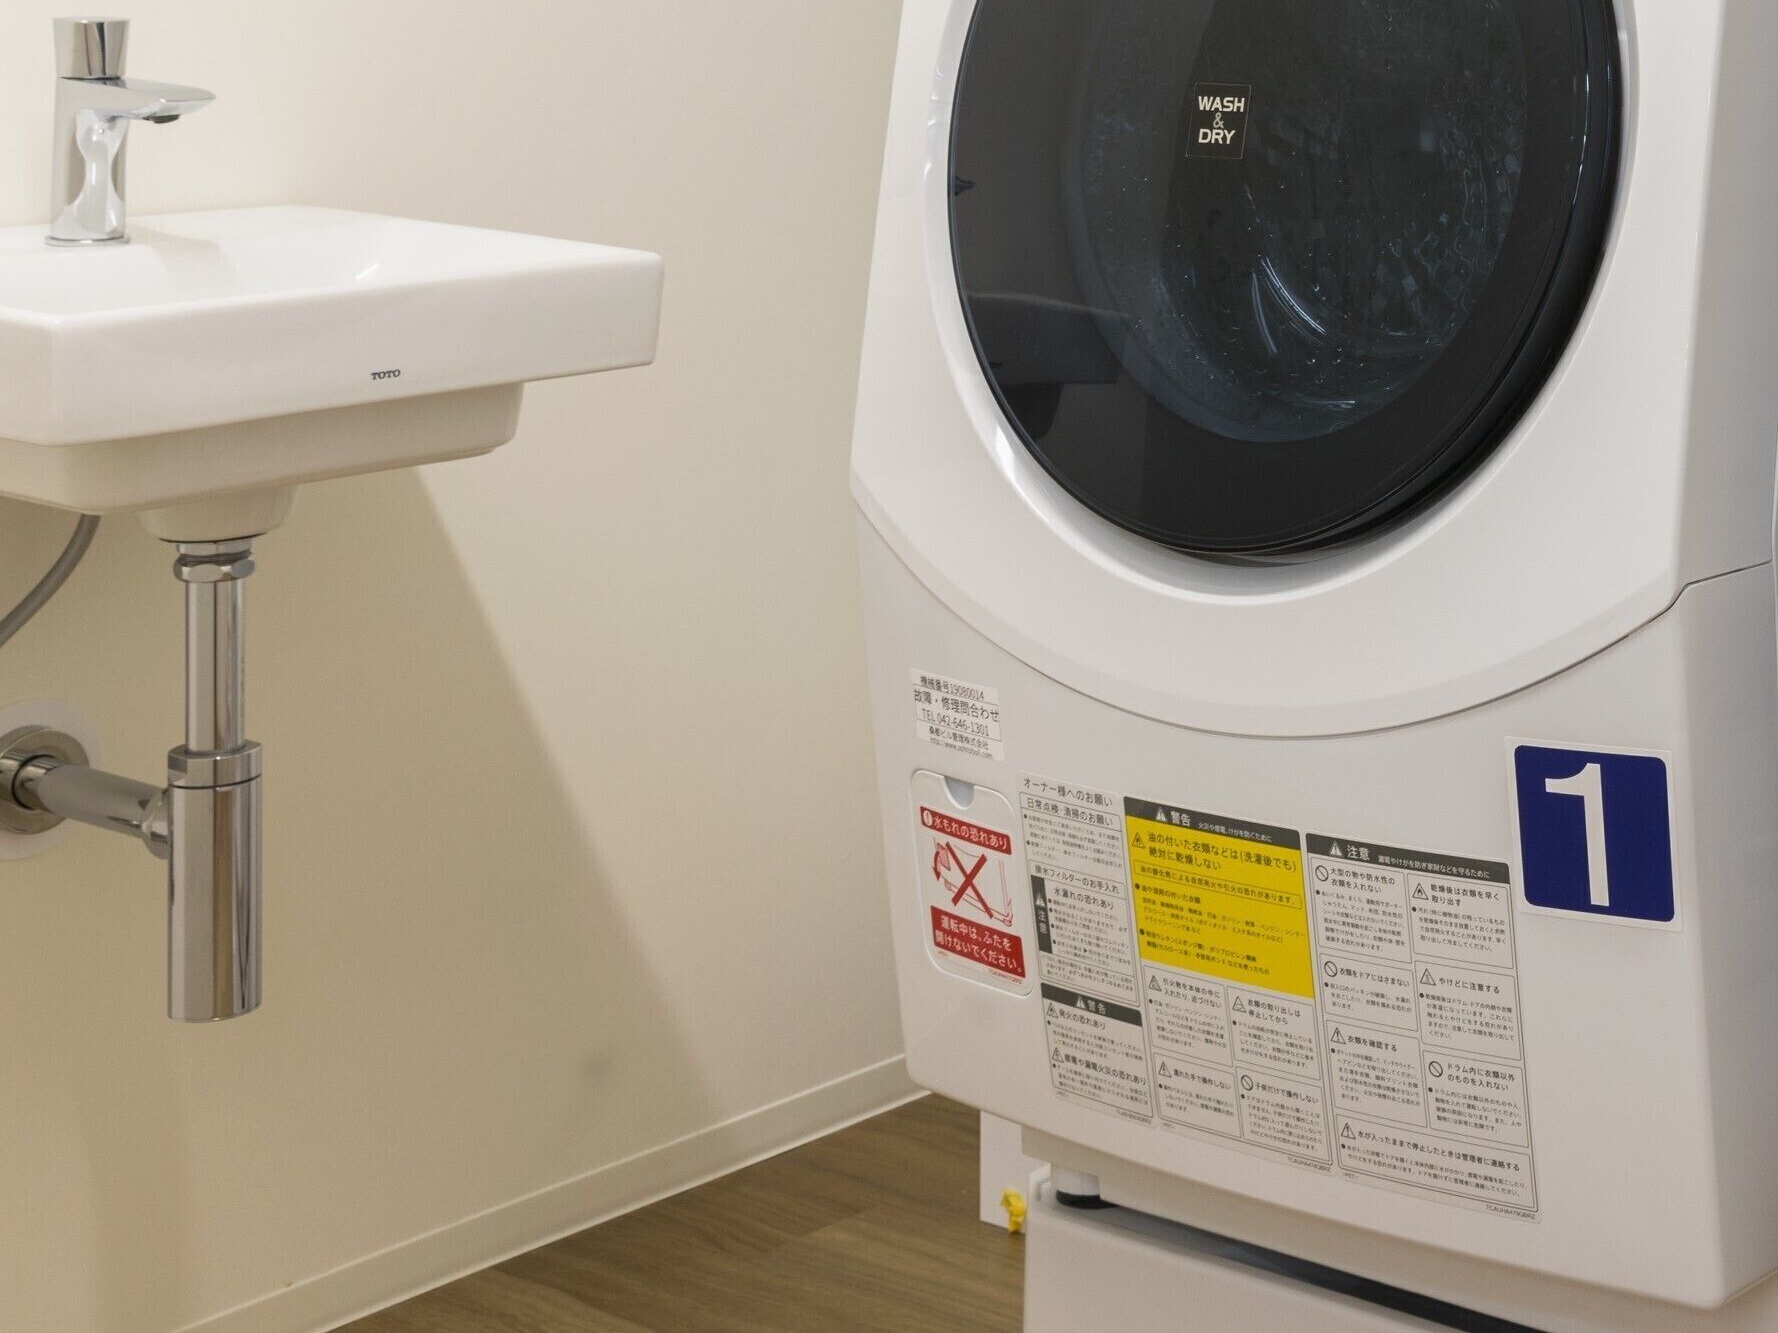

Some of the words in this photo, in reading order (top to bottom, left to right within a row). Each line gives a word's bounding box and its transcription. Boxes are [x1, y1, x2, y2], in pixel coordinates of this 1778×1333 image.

[1198, 96, 1245, 112] WASH
[1213, 112, 1224, 128] &
[1198, 129, 1236, 144] DRY
[371, 369, 400, 380] TOTO
[913, 690, 999, 722] 故障・修理問合わせ
[922, 709, 936, 721] TEL
[937, 713, 989, 737] 042-646-1301
[1024, 778, 1113, 807] オーナー様へのお願い
[933, 817, 1007, 850] 水もれの恐れあり
[1545, 763, 1609, 906] 1
[940, 914, 1012, 951] 運転中は、ふたを
[936, 930, 1023, 973] 開けないでください。
